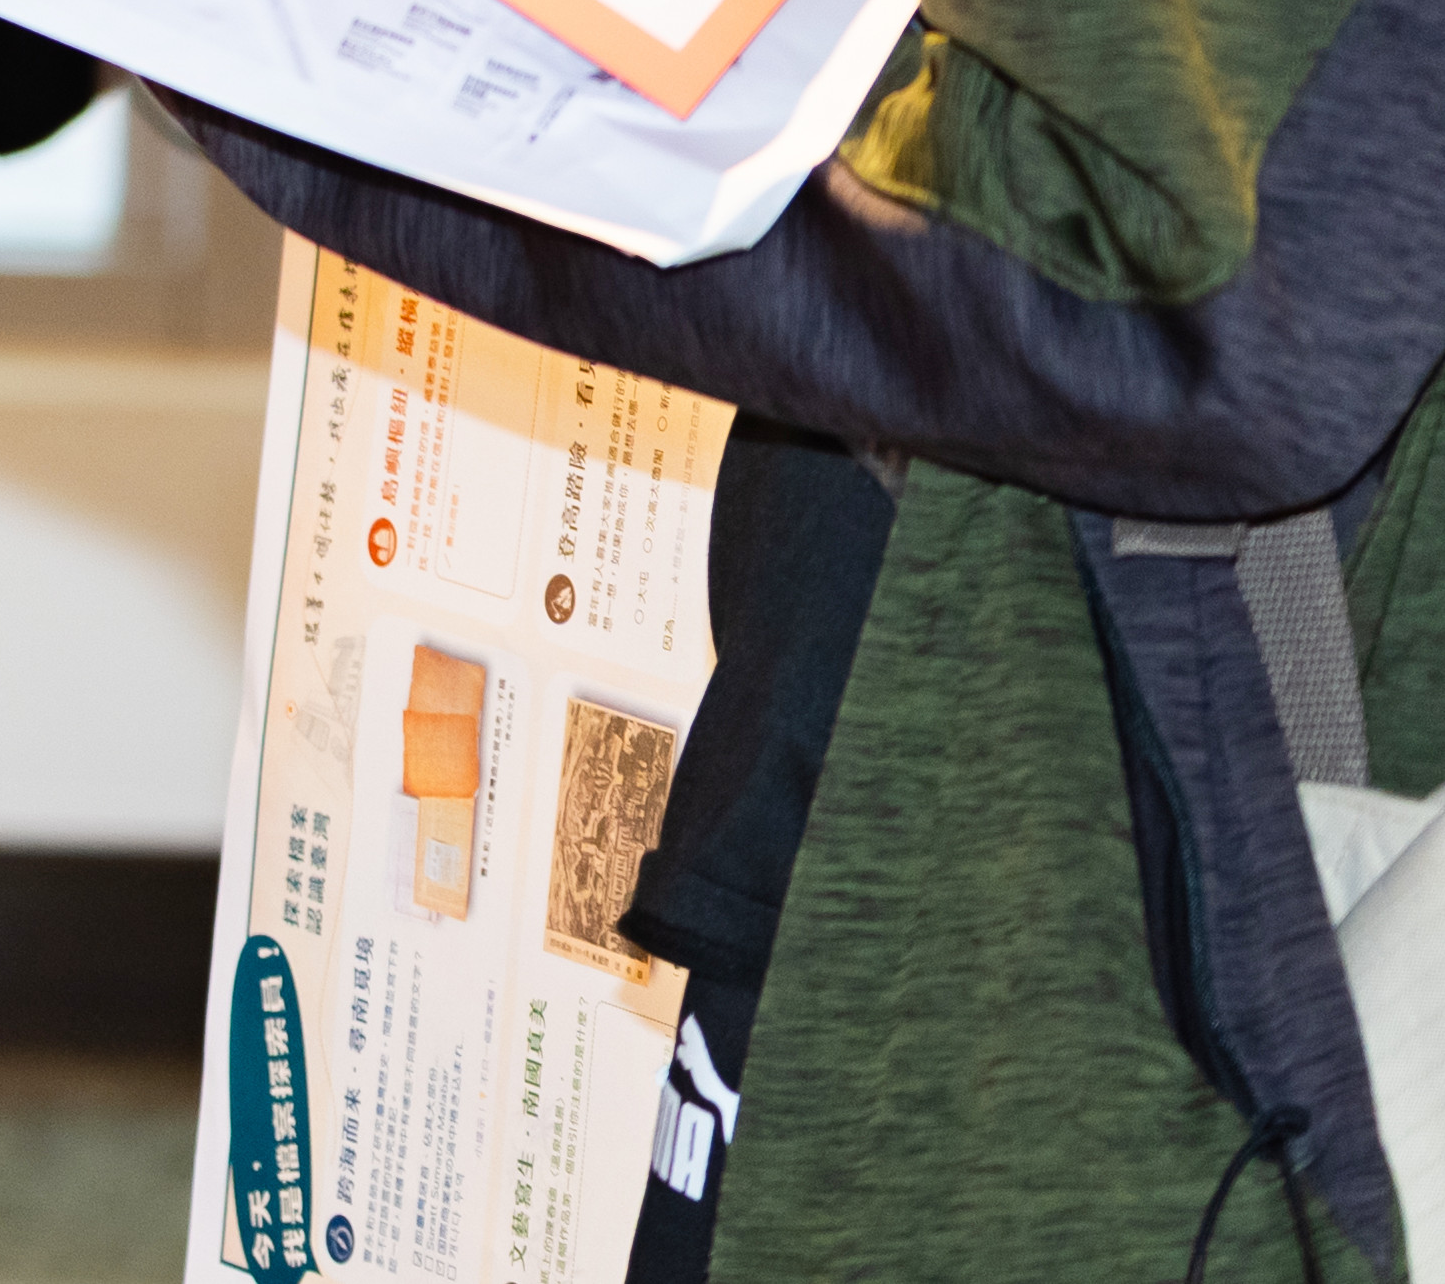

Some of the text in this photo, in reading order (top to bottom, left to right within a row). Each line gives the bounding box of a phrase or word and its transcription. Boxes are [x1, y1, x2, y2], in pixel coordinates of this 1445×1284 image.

[380, 286, 419, 506] 島嶼樞紐·縱橫
[282, 801, 310, 927] 探索檔案
[304, 808, 333, 936] 認識臺灣
[257, 942, 308, 1268] 我是檔案探索員！
[436, 1067, 450, 1130] Malabar
[248, 1158, 275, 1270] 今天，
[429, 1135, 444, 1198] Sumatra
